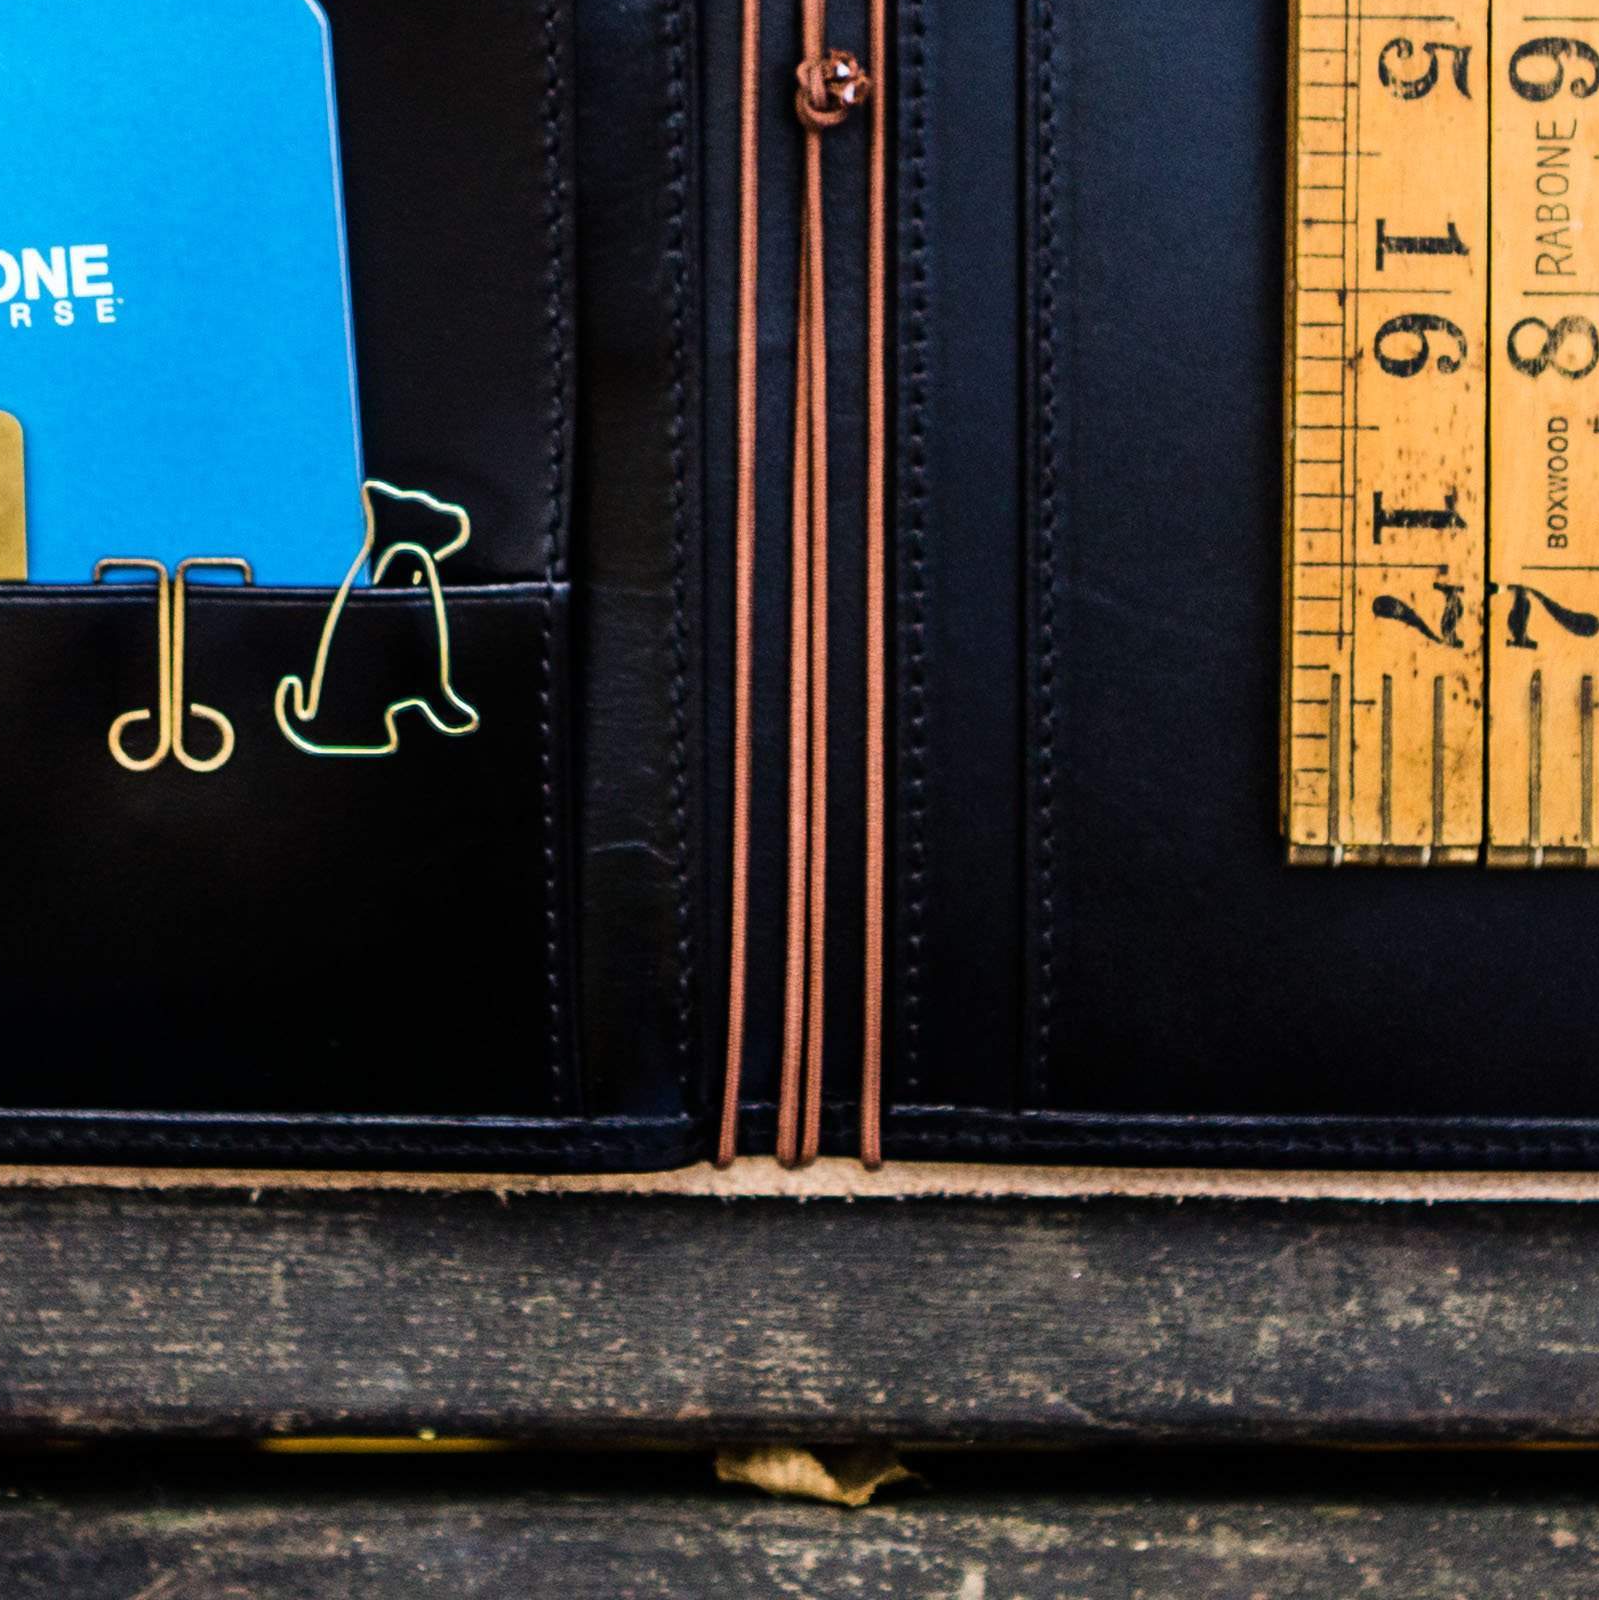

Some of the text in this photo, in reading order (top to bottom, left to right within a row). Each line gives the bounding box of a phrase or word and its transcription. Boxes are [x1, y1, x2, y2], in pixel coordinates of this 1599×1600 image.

[1536, 117, 1577, 277] RABONE
[1507, 315, 1599, 381] 8
[1547, 415, 1569, 550] BOXWOOD
[1506, 583, 1599, 650] 7
